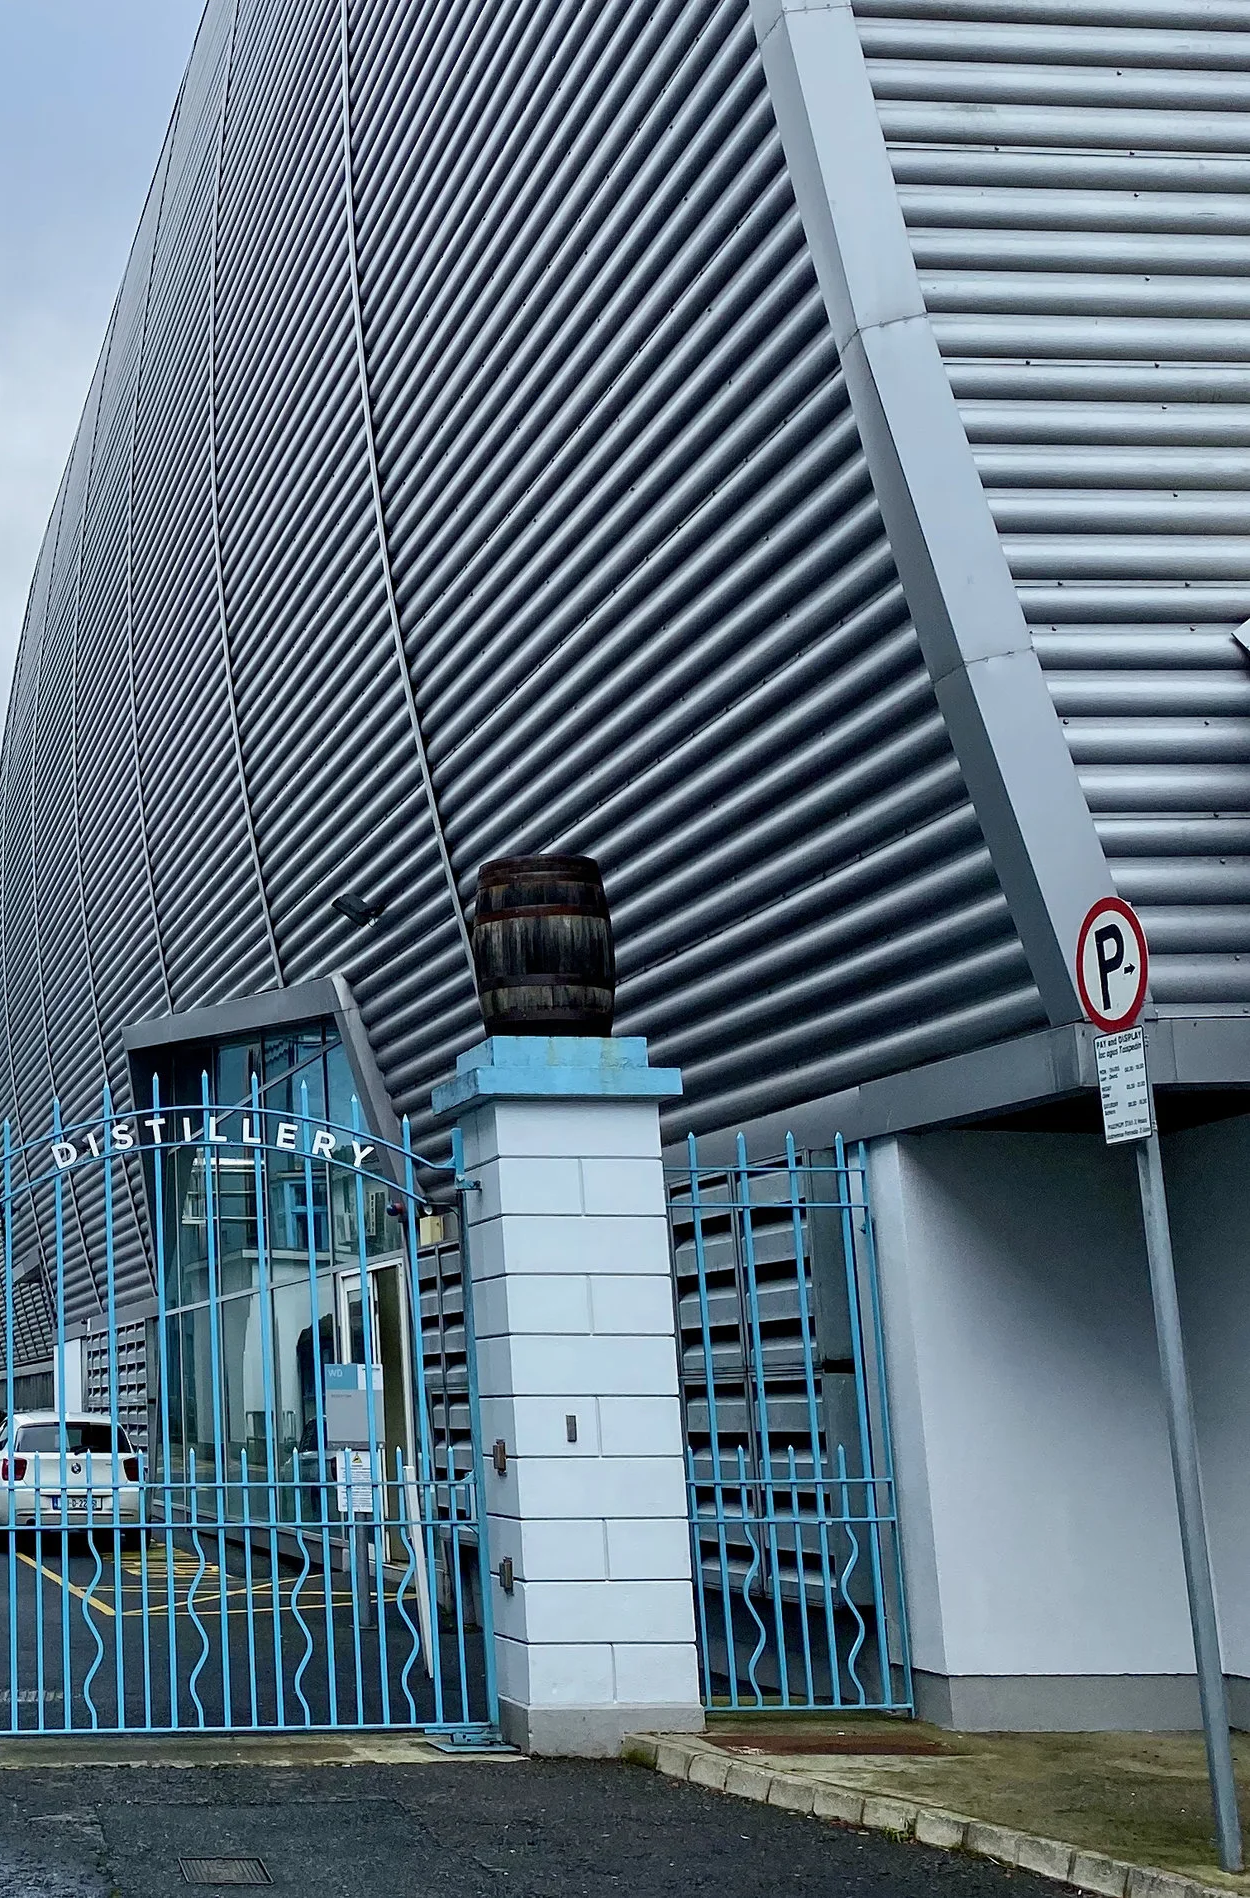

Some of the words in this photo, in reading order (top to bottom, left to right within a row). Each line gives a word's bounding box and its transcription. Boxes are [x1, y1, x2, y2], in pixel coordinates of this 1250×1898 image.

[1094, 923, 1125, 1011] P
[51, 1116, 375, 1169] DISTILLERY
[327, 1368, 343, 1378] WD
